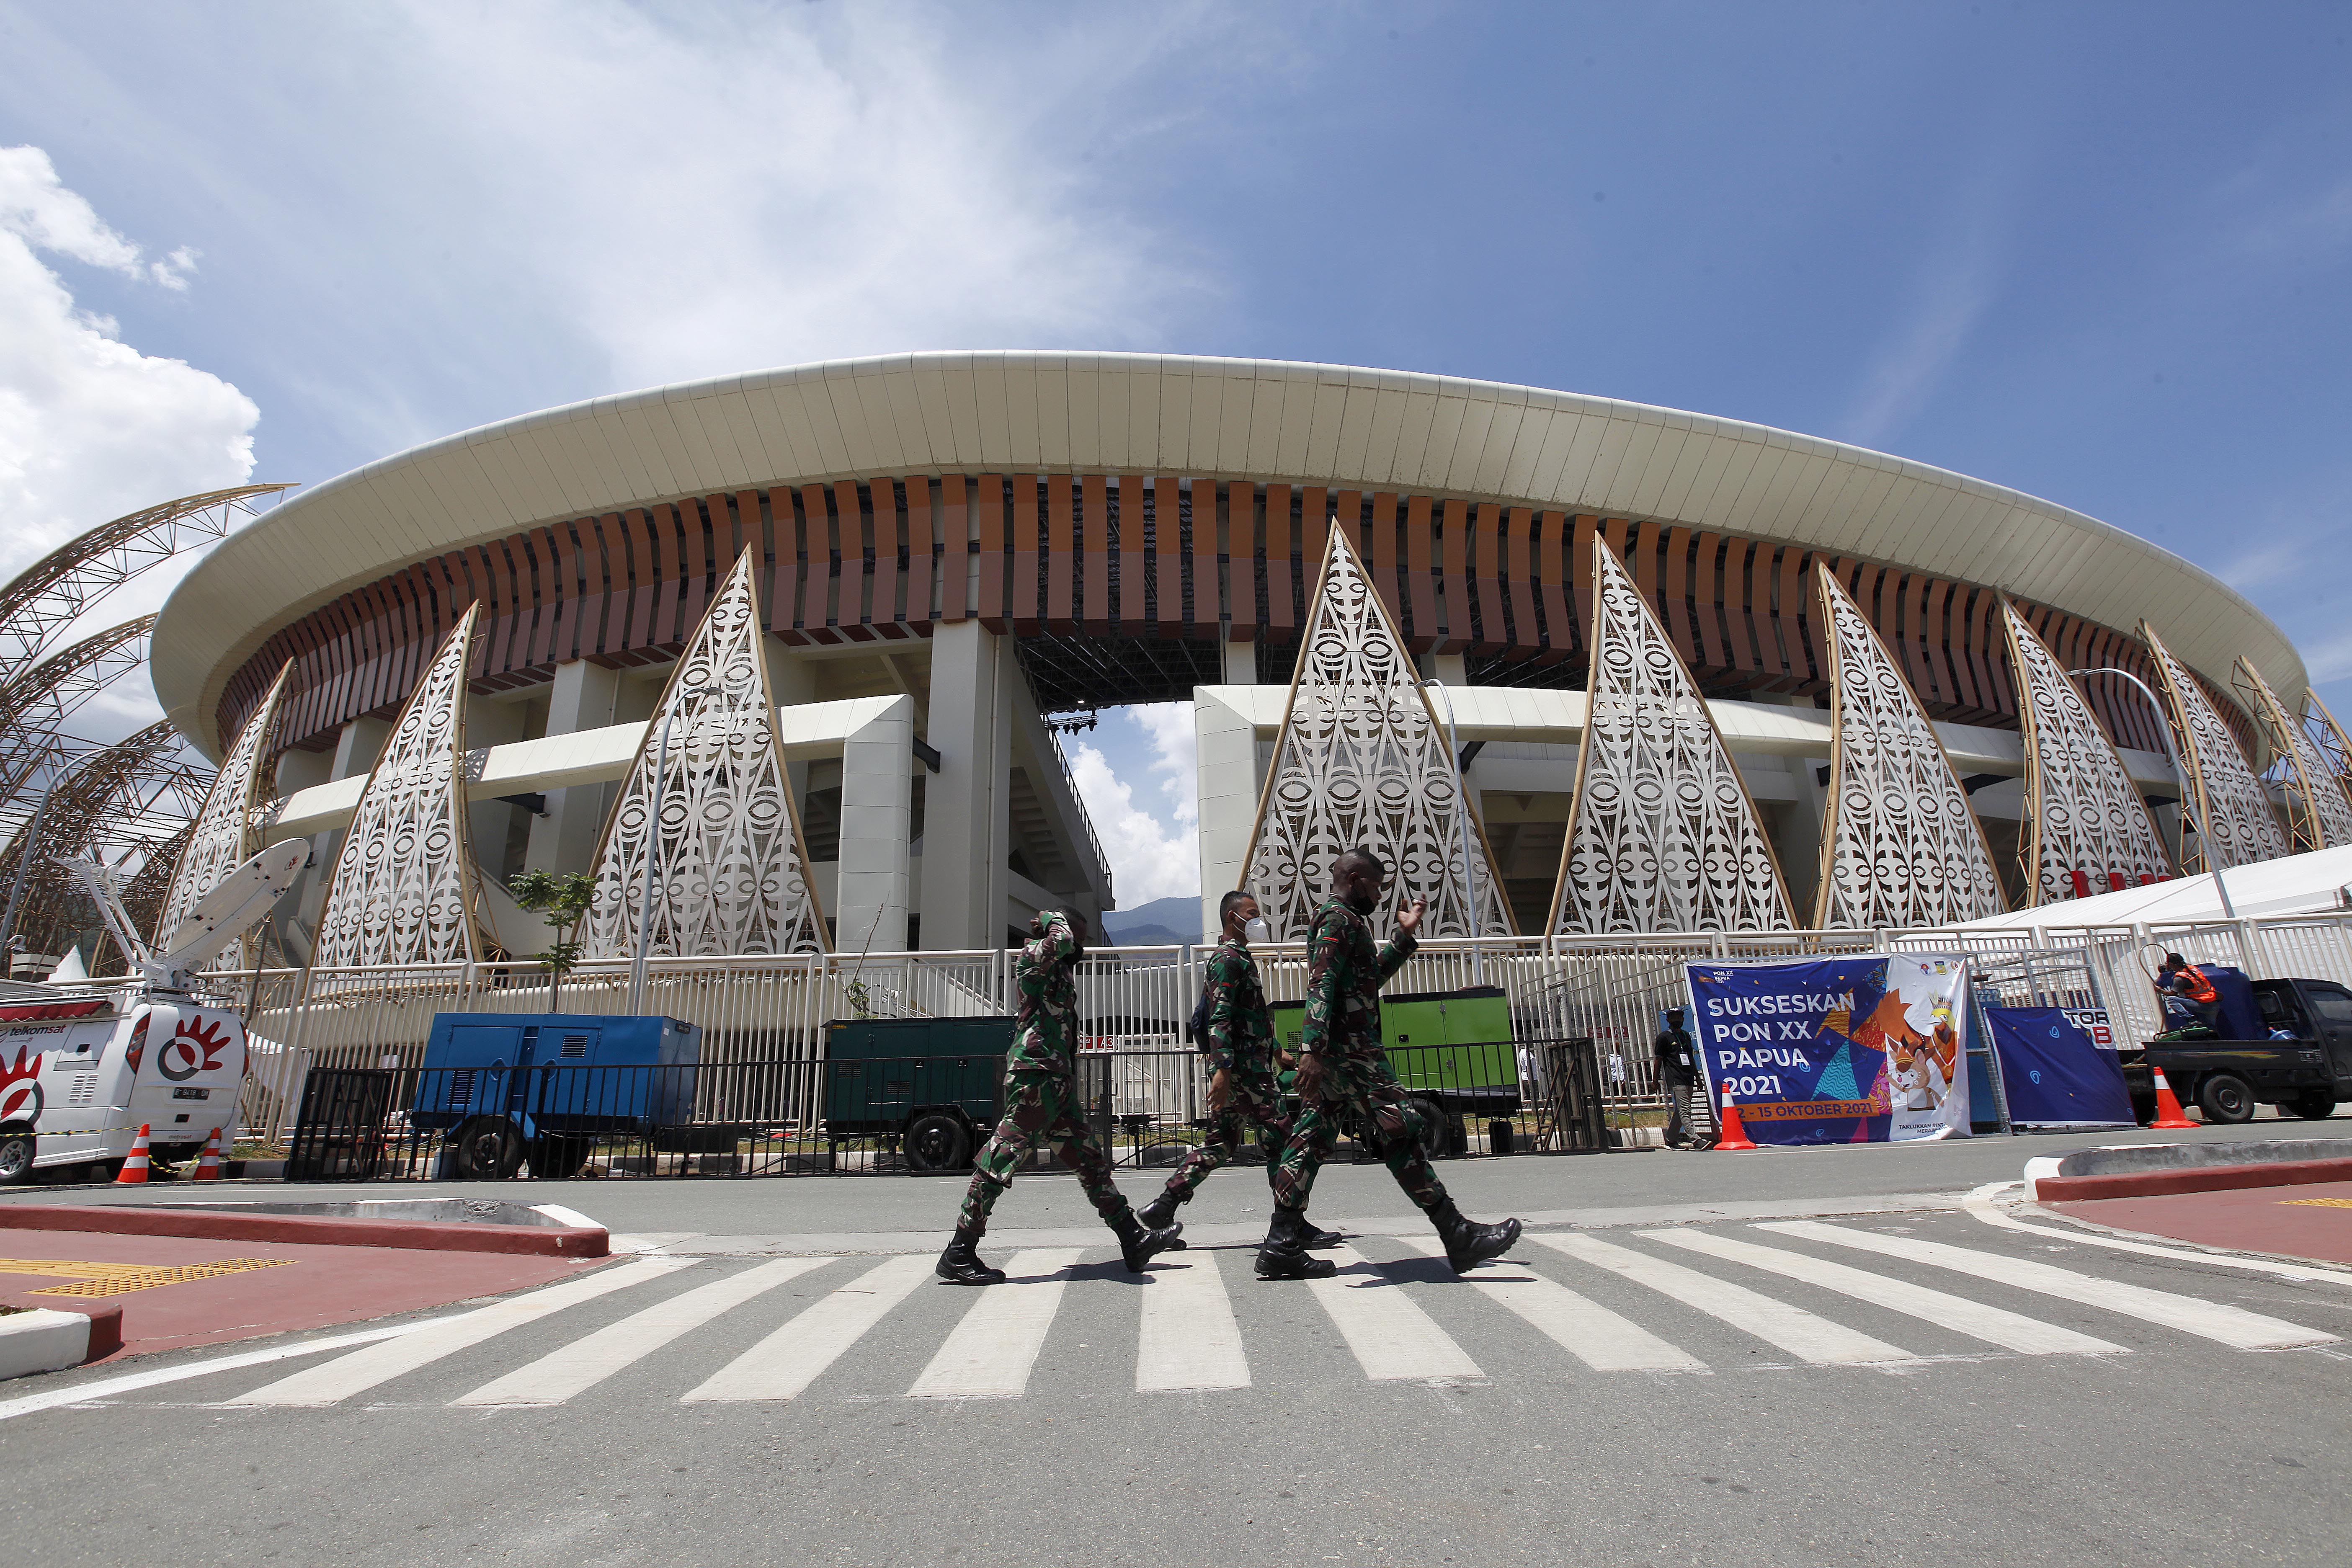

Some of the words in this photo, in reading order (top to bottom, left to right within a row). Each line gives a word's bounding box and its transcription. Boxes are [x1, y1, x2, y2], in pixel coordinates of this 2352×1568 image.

[1708, 993, 1855, 1016] SUKSESKAN
[10, 1024, 67, 1036] telkomsat
[1713, 1022, 1771, 1042] PON
[1777, 1021, 1813, 1040] XX
[2092, 1026, 2112, 1043] B
[1718, 1048, 1810, 1069] PAPUA
[1724, 1075, 1782, 1096] 2021
[1759, 1106, 1772, 1117] 15
[1776, 1104, 1842, 1117] OKTOBER
[1846, 1103, 1873, 1114] 2021
